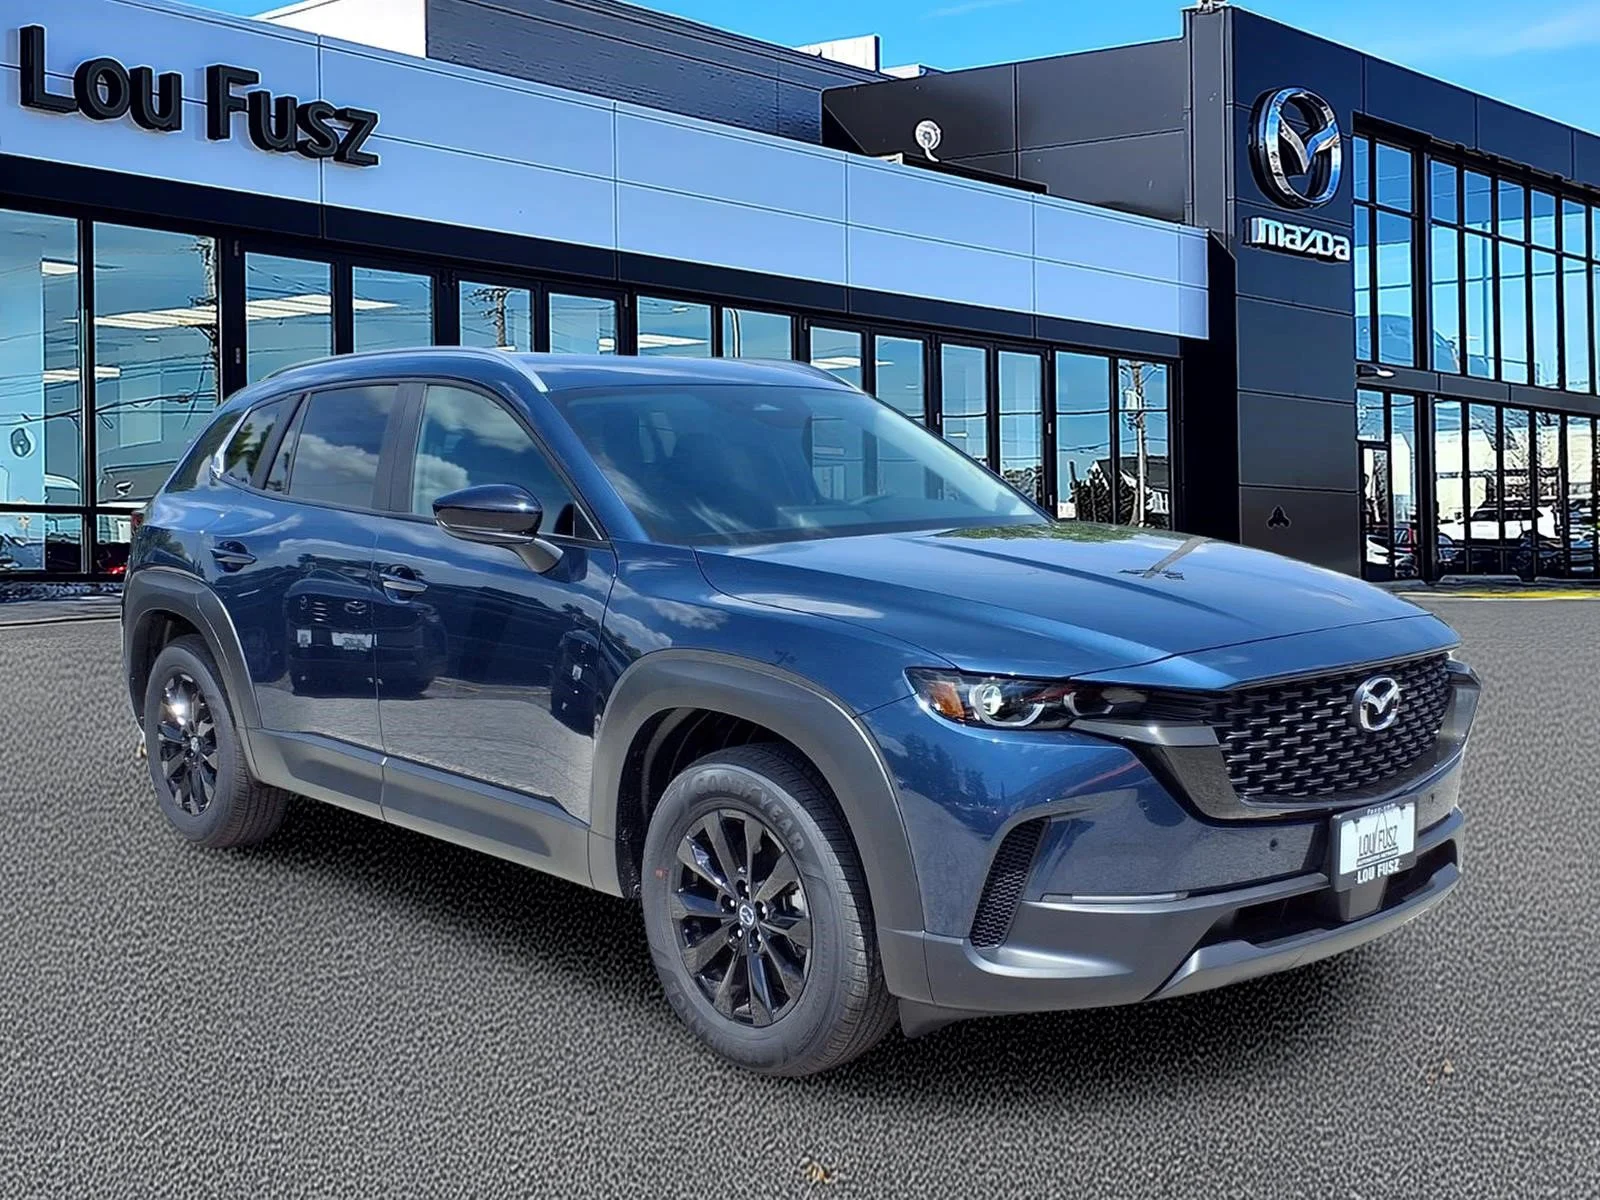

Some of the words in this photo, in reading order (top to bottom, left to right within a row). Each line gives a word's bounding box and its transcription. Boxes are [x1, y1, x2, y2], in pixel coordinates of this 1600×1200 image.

[19, 25, 182, 131] Lou
[206, 64, 379, 166] Fusz
[1250, 216, 1351, 262] mazda
[1358, 832, 1376, 857] LOU
[1377, 825, 1398, 851] FUSZ
[1357, 865, 1375, 884] LOU
[1377, 858, 1400, 878] FUSZ
